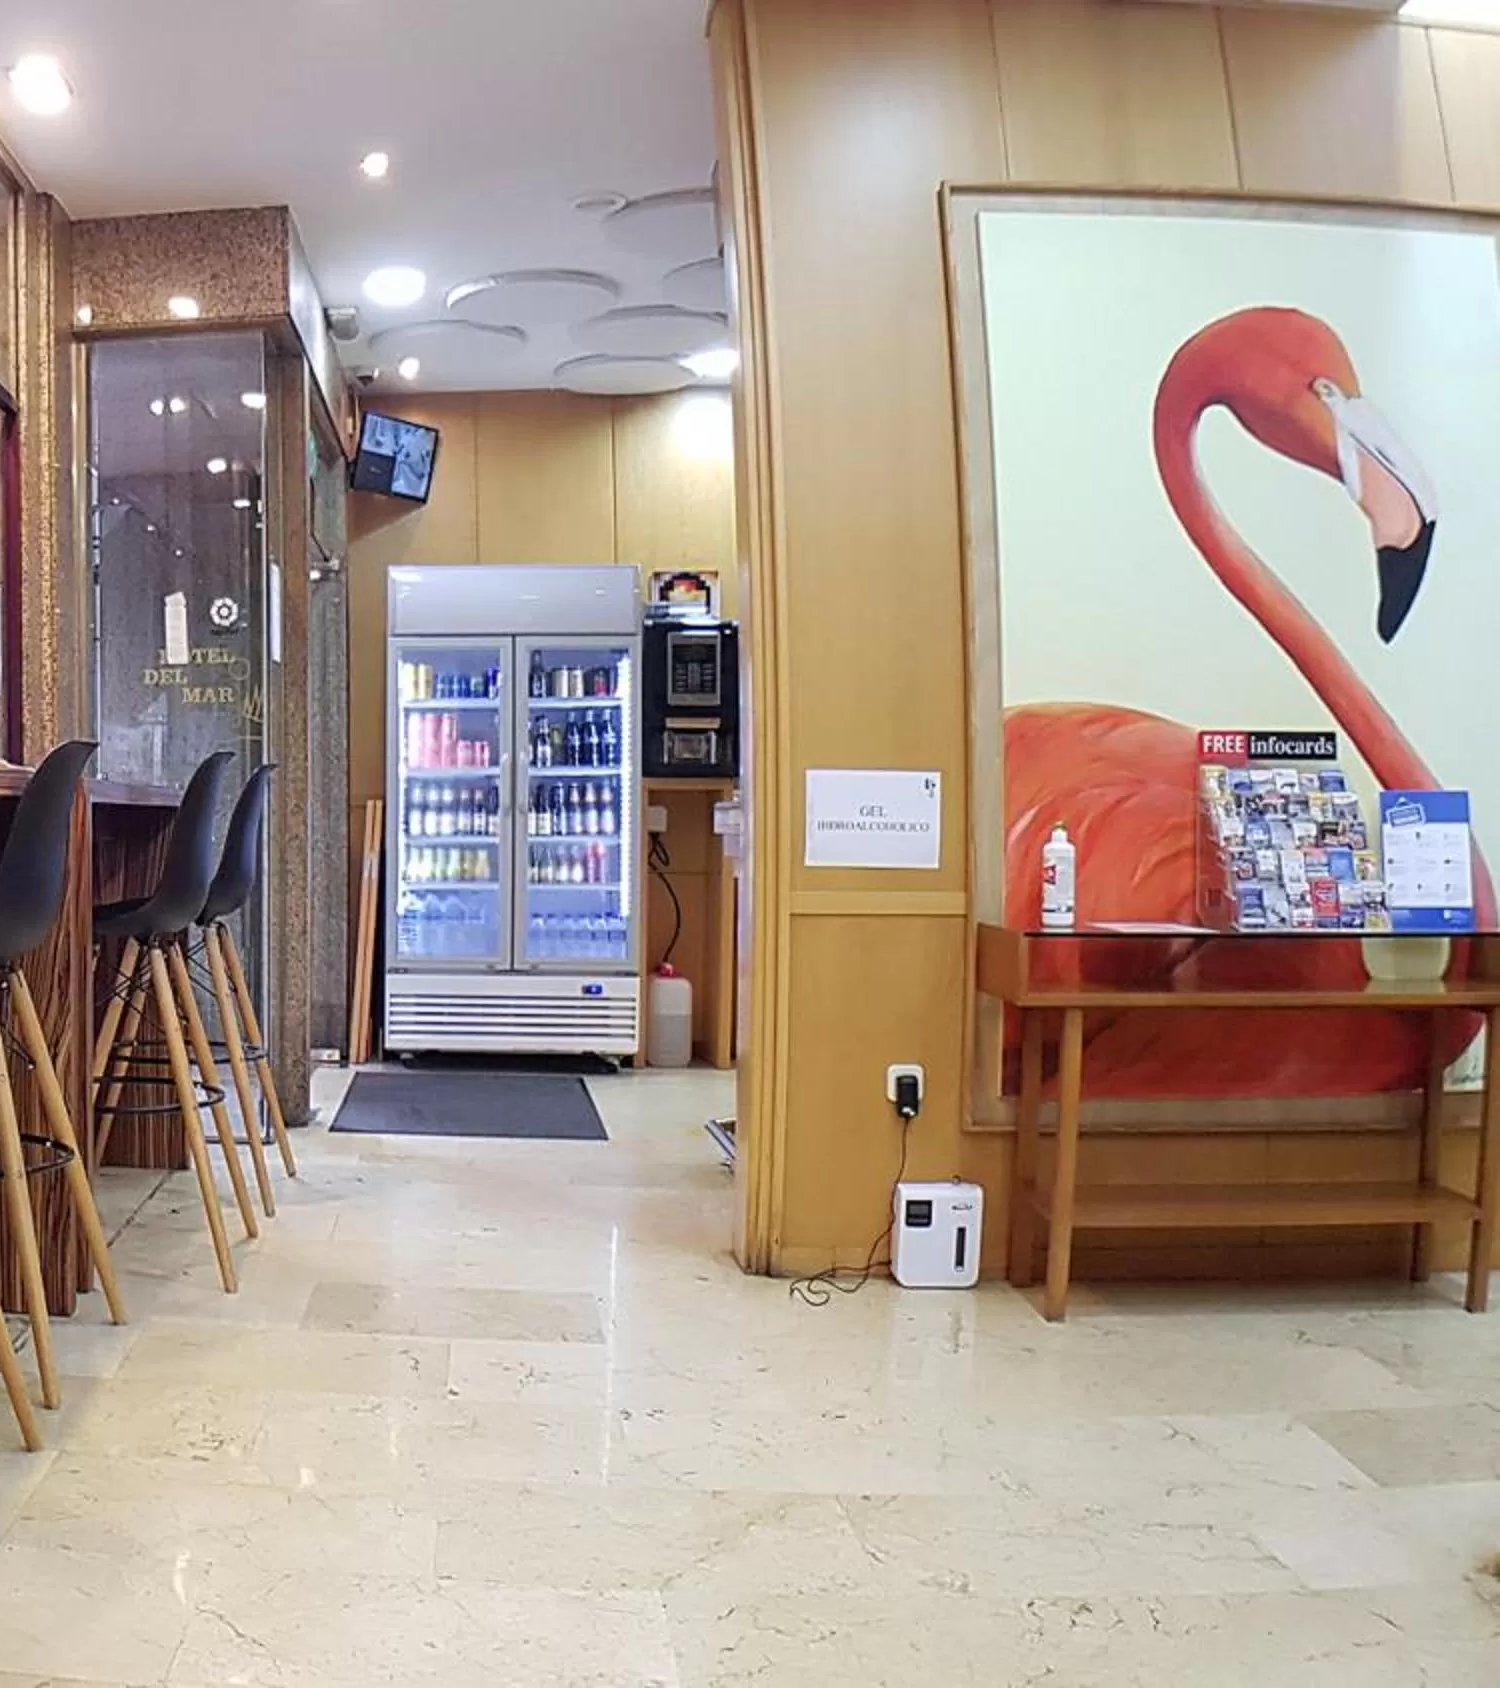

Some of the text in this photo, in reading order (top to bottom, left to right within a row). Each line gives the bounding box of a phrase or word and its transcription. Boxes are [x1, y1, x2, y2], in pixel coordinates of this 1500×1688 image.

[158, 648, 236, 665] HTEL
[143, 669, 188, 686] DEL
[182, 687, 235, 704] MAR
[1202, 735, 1334, 755] FREE infocards
[859, 805, 889, 818] GEL
